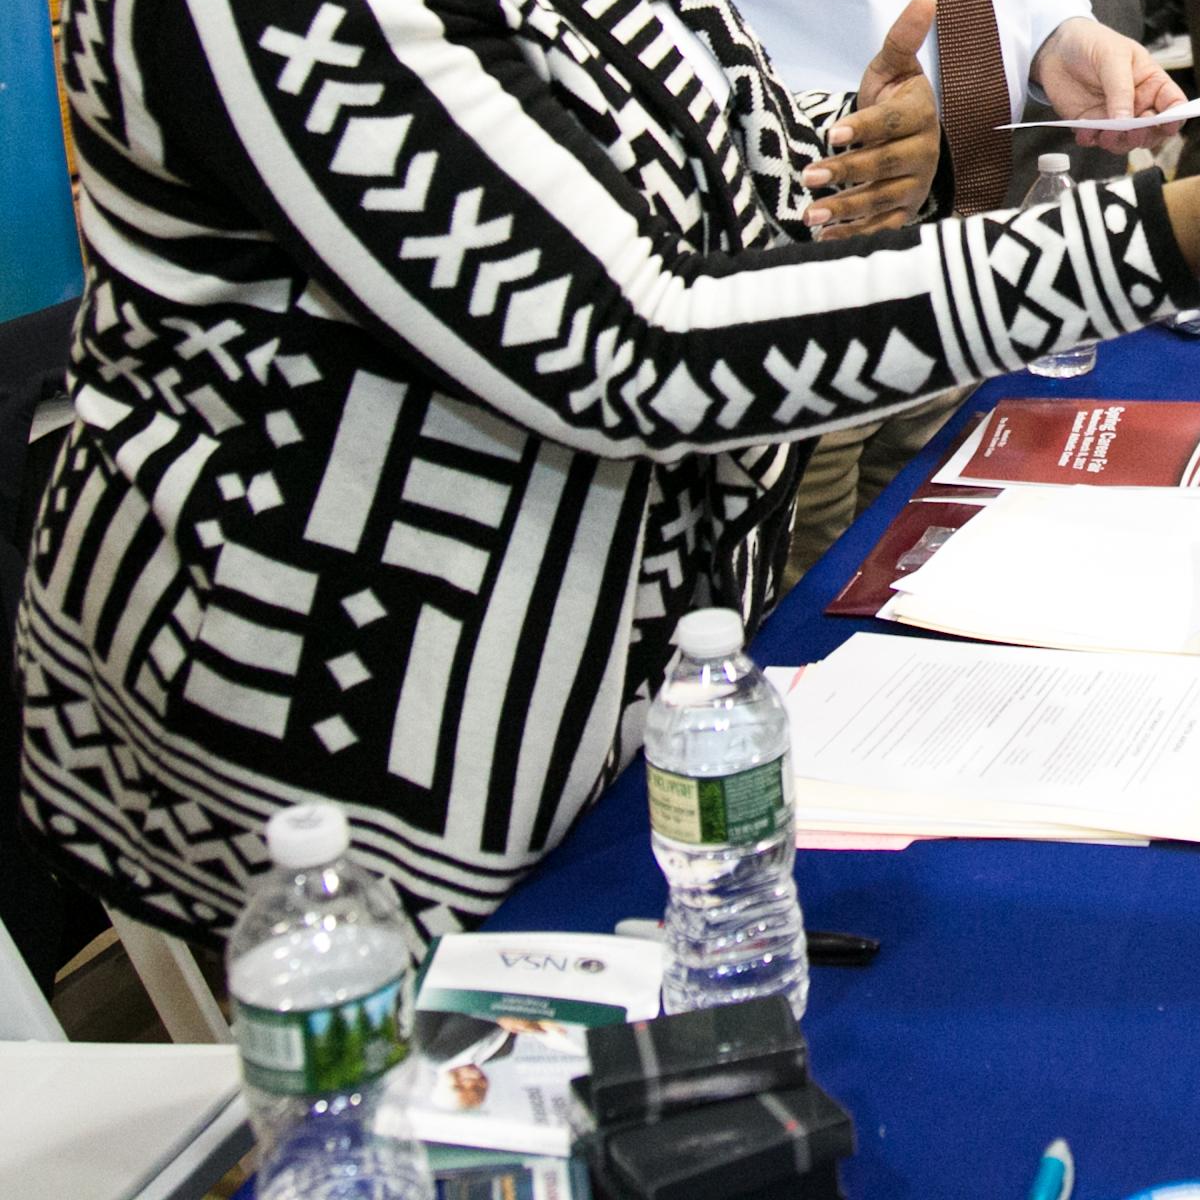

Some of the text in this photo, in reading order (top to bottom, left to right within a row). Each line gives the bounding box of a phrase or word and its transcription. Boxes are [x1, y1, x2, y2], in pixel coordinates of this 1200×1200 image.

[1087, 406, 1125, 473] Spring Career Fair
[500, 951, 568, 972] NSA
